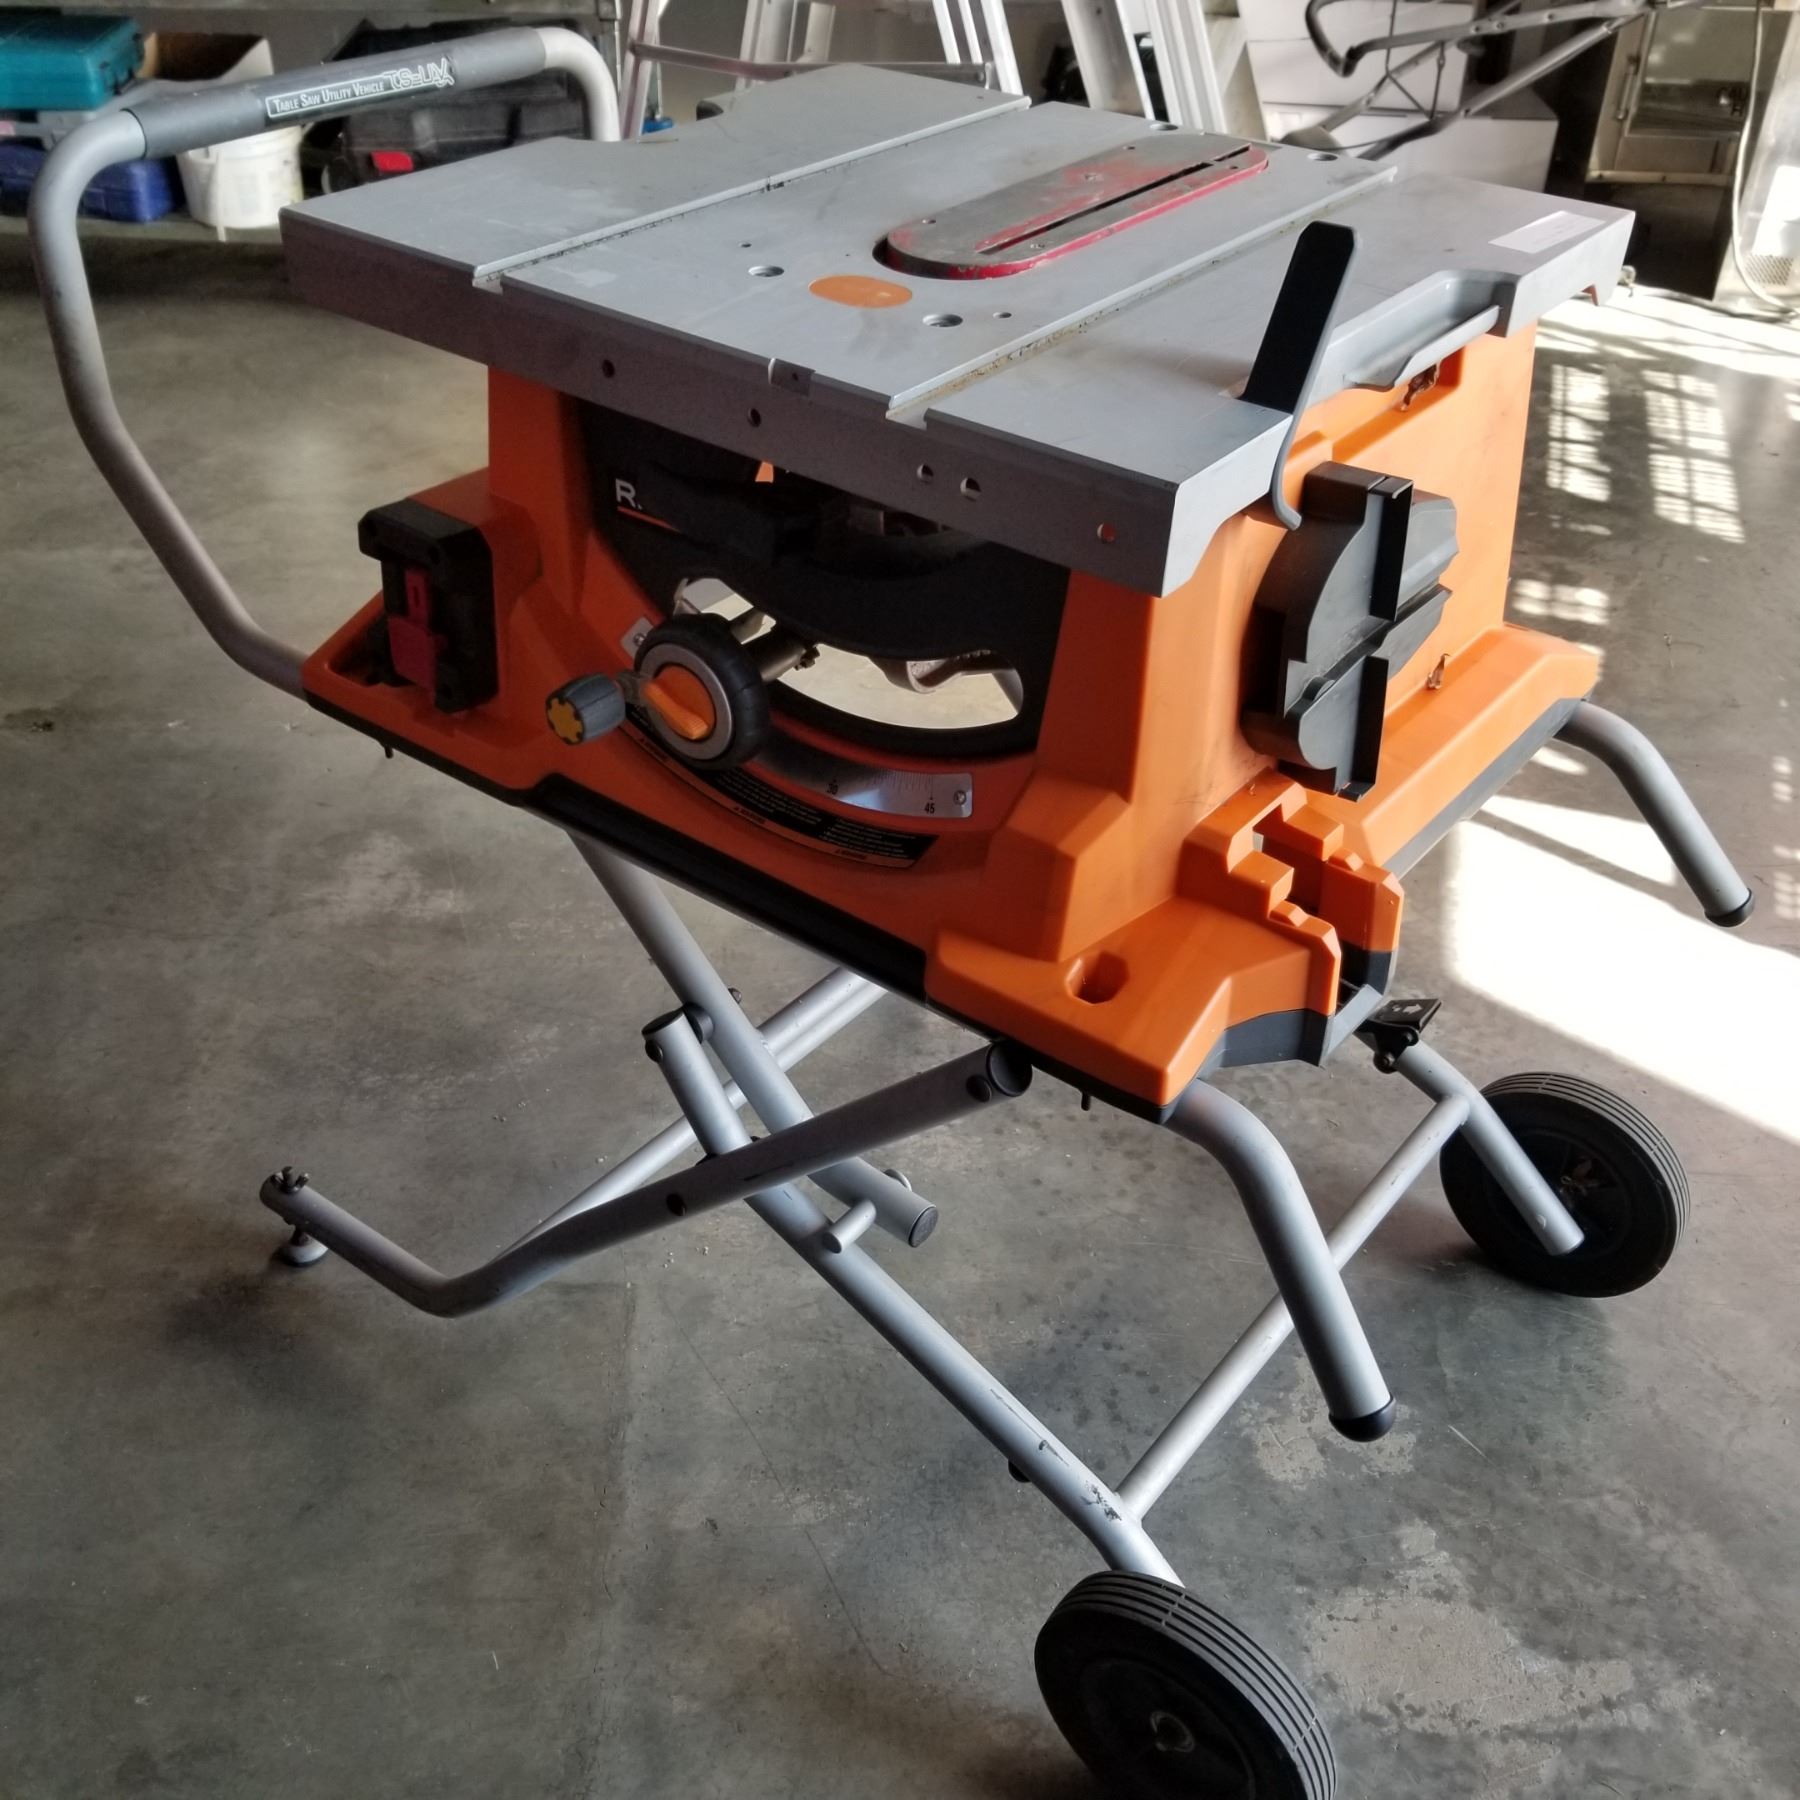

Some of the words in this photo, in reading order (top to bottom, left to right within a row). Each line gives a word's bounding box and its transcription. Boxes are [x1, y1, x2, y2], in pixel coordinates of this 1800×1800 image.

[273, 99, 299, 113] TABLE
[300, 94, 320, 107] SAW
[322, 86, 351, 102] UTILITY
[353, 81, 385, 97] VEHICLE
[826, 783, 839, 795] 30
[924, 802, 935, 814] 45
